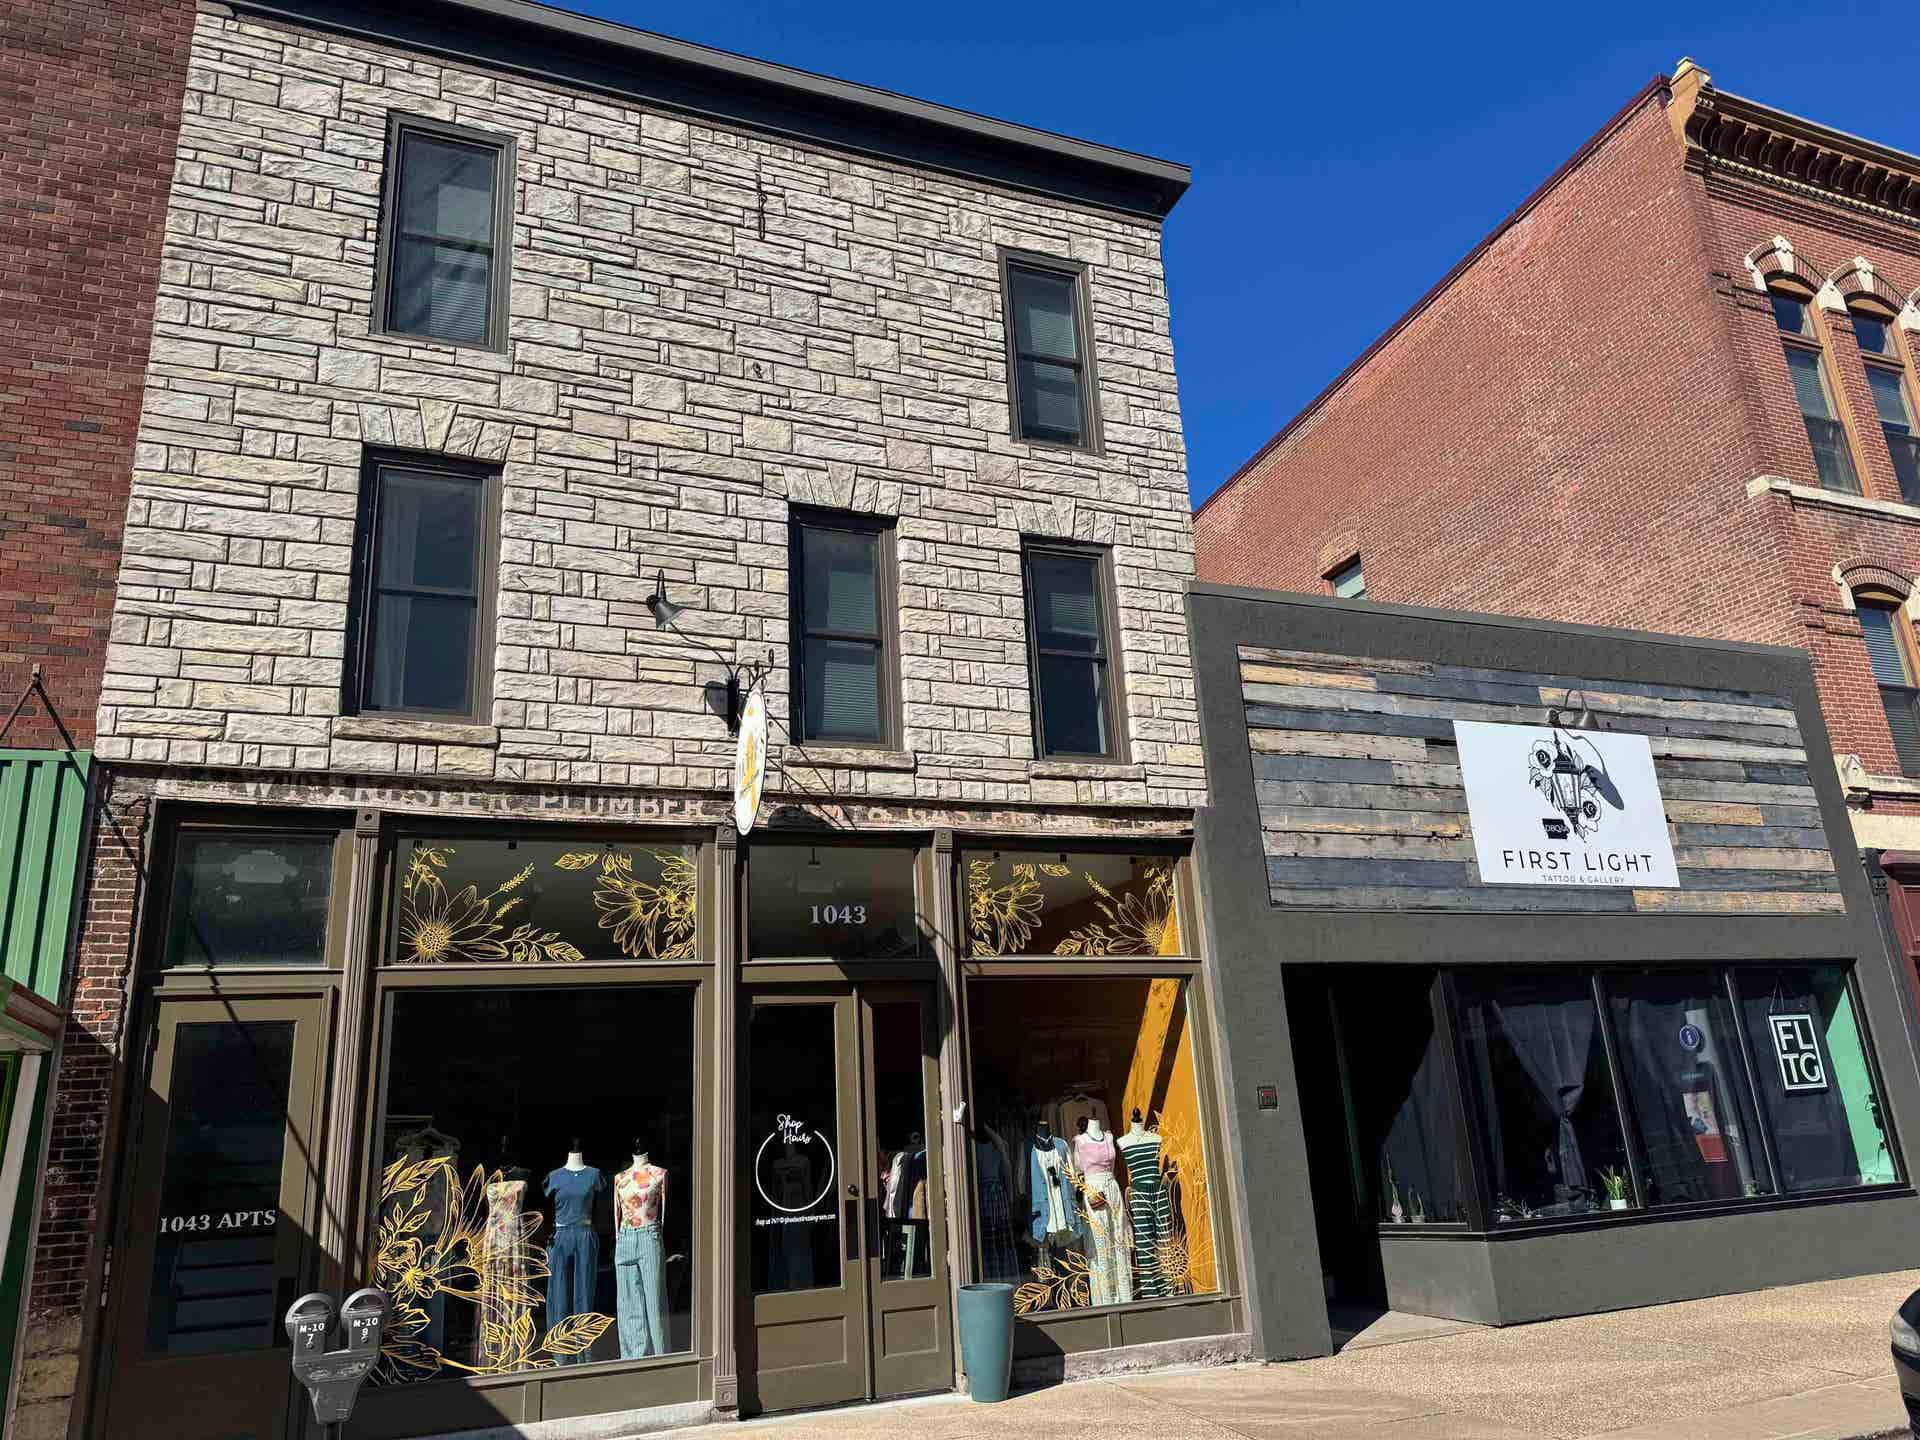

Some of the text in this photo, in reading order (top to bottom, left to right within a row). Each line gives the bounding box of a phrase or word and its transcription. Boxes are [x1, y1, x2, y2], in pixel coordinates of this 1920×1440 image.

[1502, 849, 1652, 873] FIRST LIGHT
[1543, 874, 1577, 883] TATTOO
[1586, 875, 1625, 884] GALLERY
[810, 904, 867, 925] 1043
[1776, 1020, 1815, 1051] FL
[1781, 1051, 1821, 1083] TG
[776, 1113, 804, 1134] Shop
[783, 1128, 812, 1145] Hours
[159, 1209, 276, 1233] 1043 APTS
[300, 1322, 325, 1333] M-10
[353, 1317, 378, 1328] M-10
